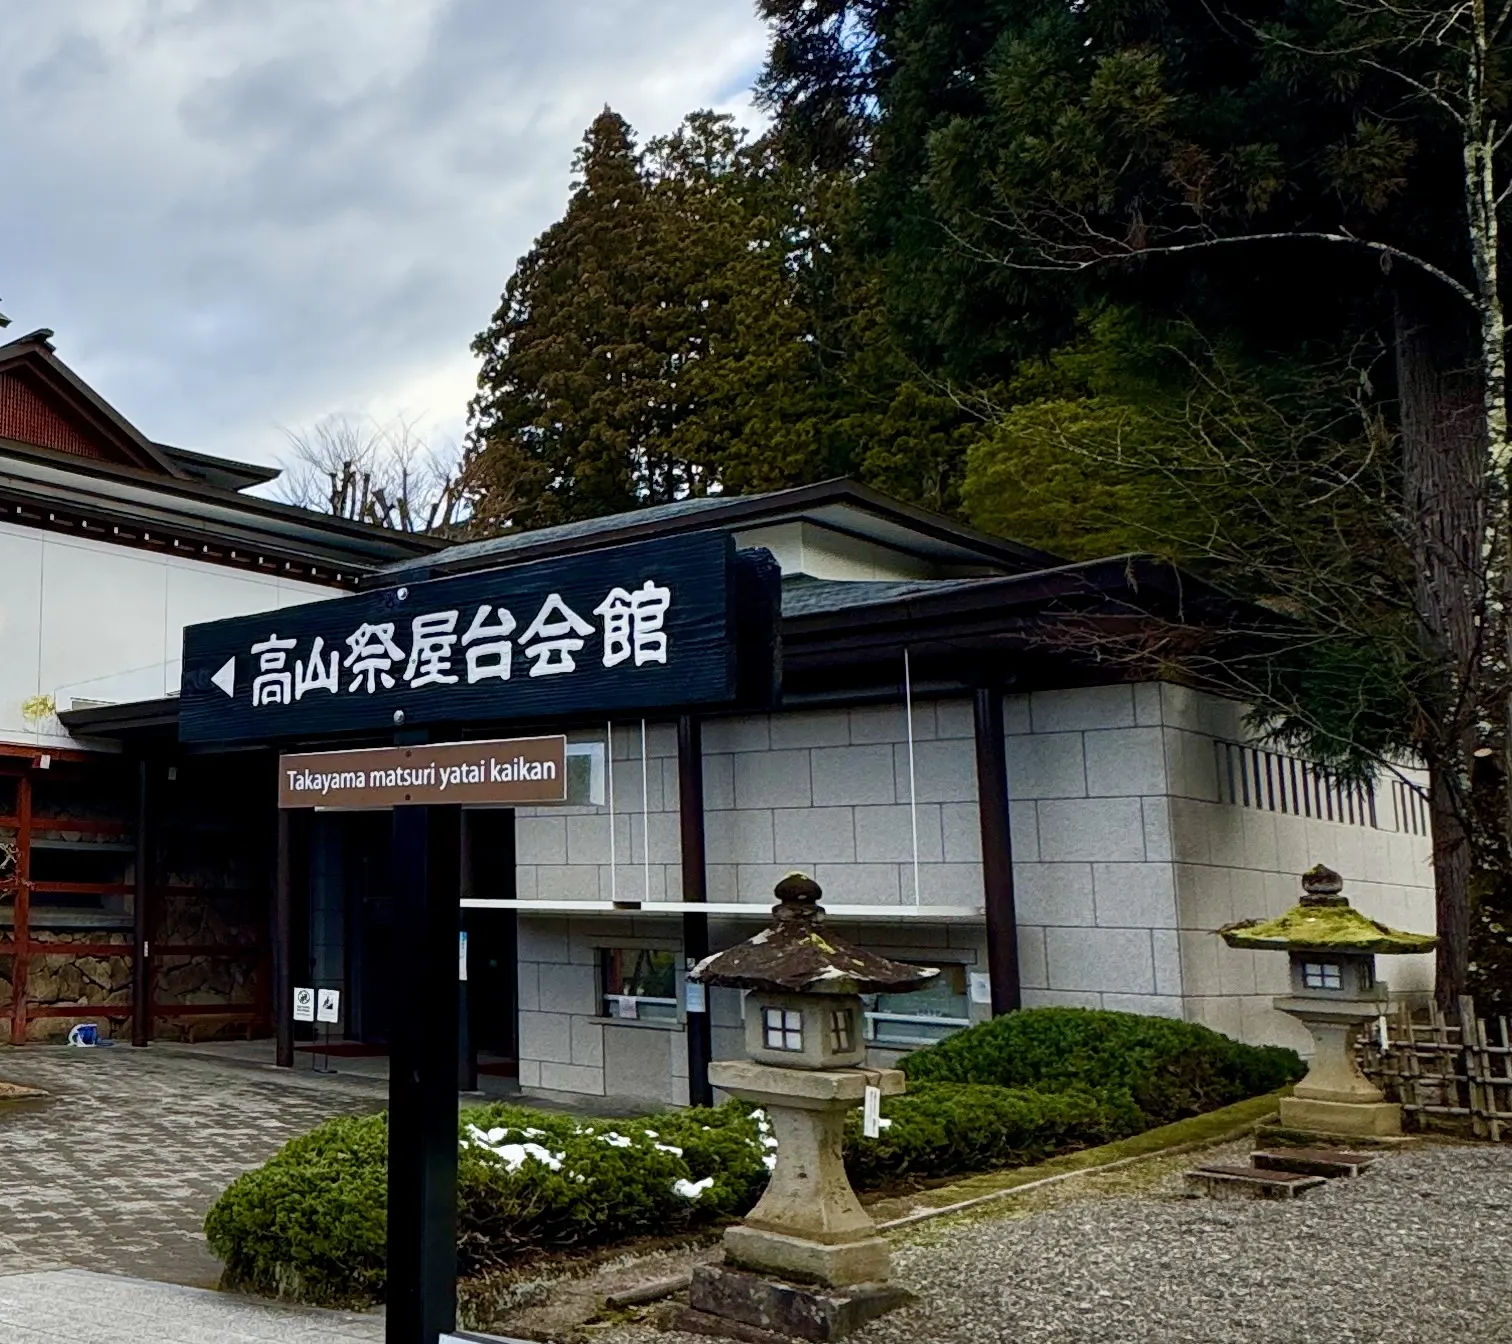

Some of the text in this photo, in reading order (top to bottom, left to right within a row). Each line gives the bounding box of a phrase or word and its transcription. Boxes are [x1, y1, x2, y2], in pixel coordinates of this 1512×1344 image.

[251, 580, 671, 707] 高山祭屋台会館
[287, 756, 556, 795] Takayama matsuri yatai kaikan
